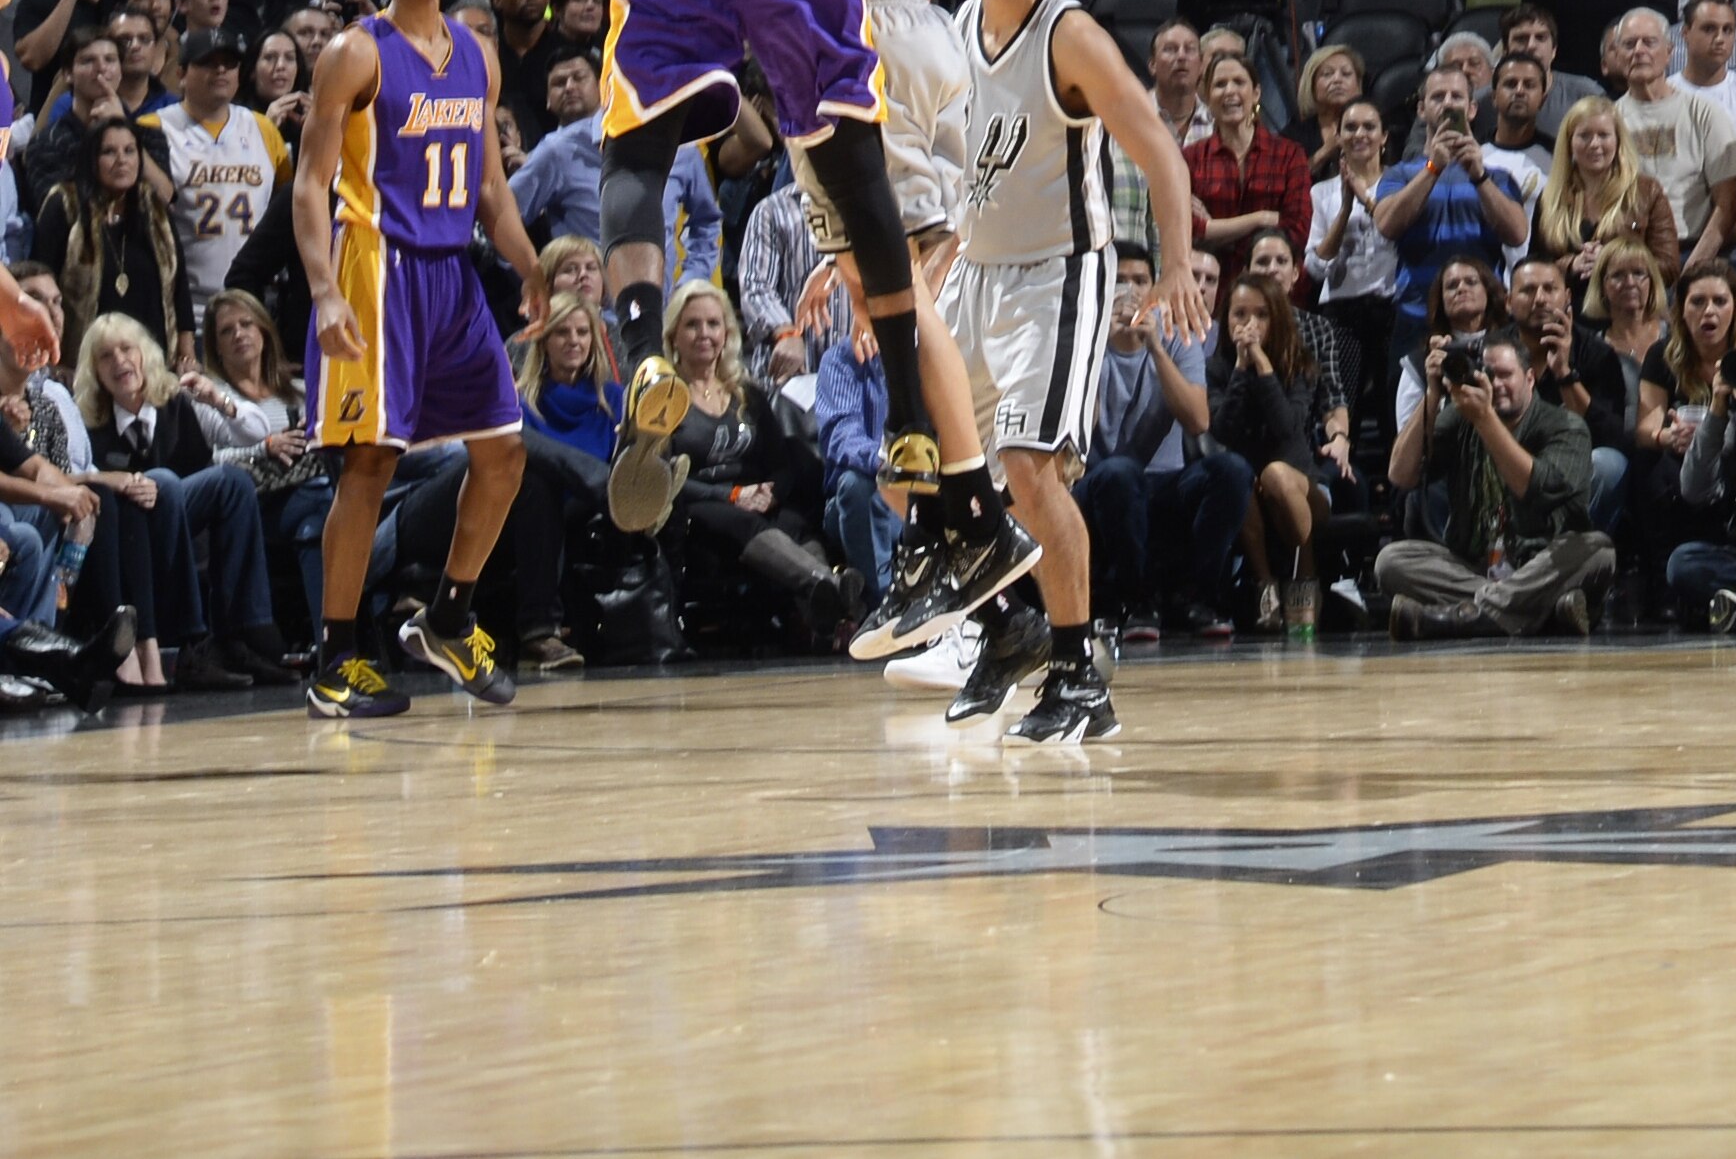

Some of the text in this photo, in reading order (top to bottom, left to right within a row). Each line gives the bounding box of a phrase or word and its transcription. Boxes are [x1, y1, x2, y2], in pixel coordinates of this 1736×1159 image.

[397, 91, 484, 139] LAKERS
[187, 160, 264, 188] LAKERS
[422, 141, 470, 209] 11
[196, 192, 255, 237] 24
